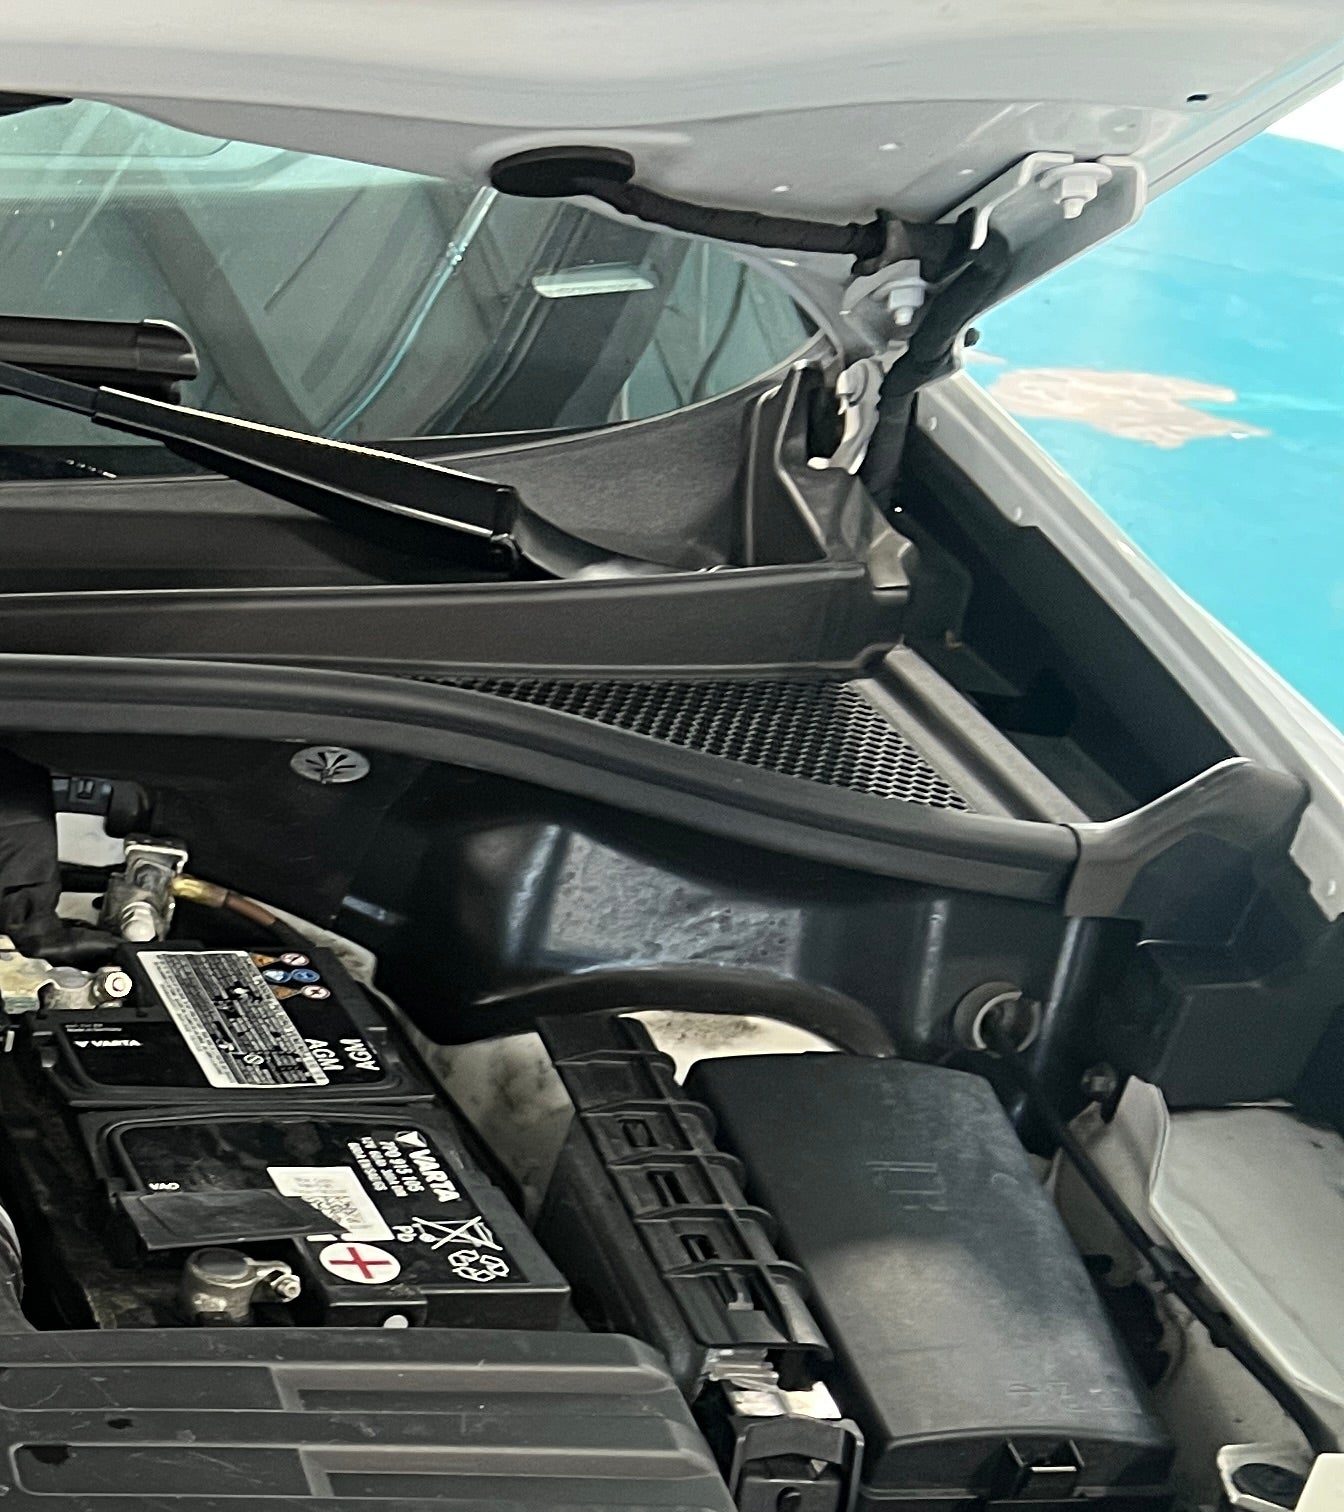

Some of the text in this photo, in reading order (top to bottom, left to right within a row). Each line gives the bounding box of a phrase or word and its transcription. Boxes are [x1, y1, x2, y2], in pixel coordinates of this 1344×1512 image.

[304, 1038, 344, 1071] AGM
[339, 1038, 380, 1071] AGM
[408, 1148, 461, 1203] VARTA
